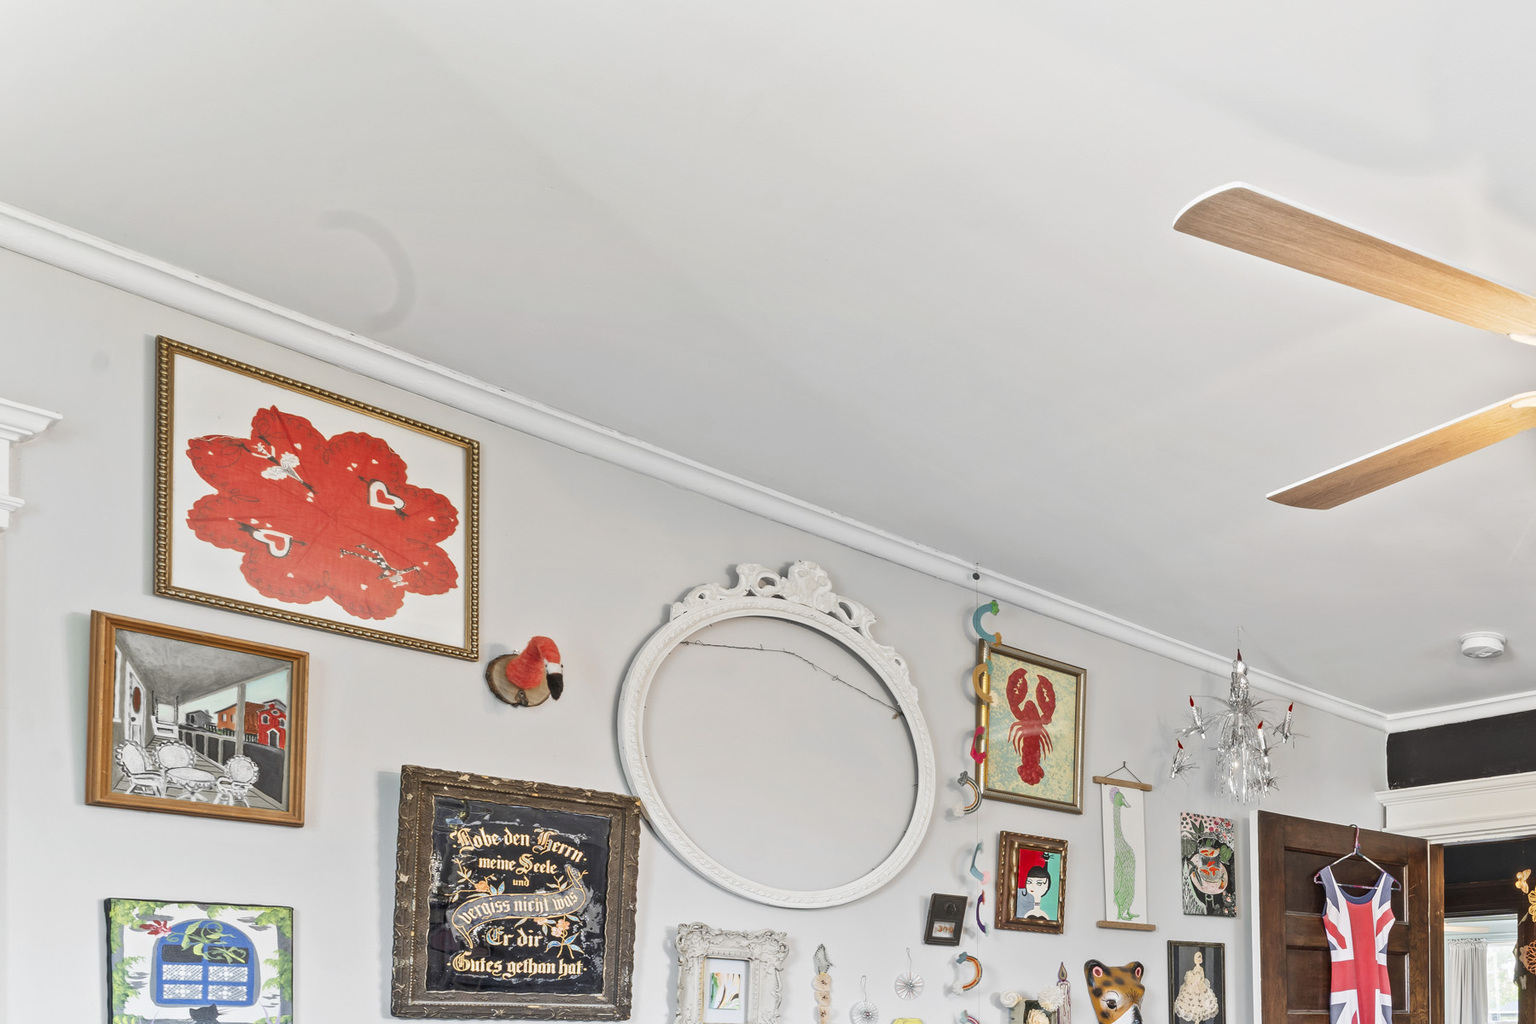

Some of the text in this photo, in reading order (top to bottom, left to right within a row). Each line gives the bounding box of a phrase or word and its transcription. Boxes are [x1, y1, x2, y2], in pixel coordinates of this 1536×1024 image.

[504, 827, 530, 847] den
[478, 853, 558, 875] meine Seele
[512, 875, 530, 887] und
[457, 891, 579, 925] vergiss nicht was
[485, 926, 543, 947] Er dir
[451, 951, 584, 980] Gutes gethan hat
